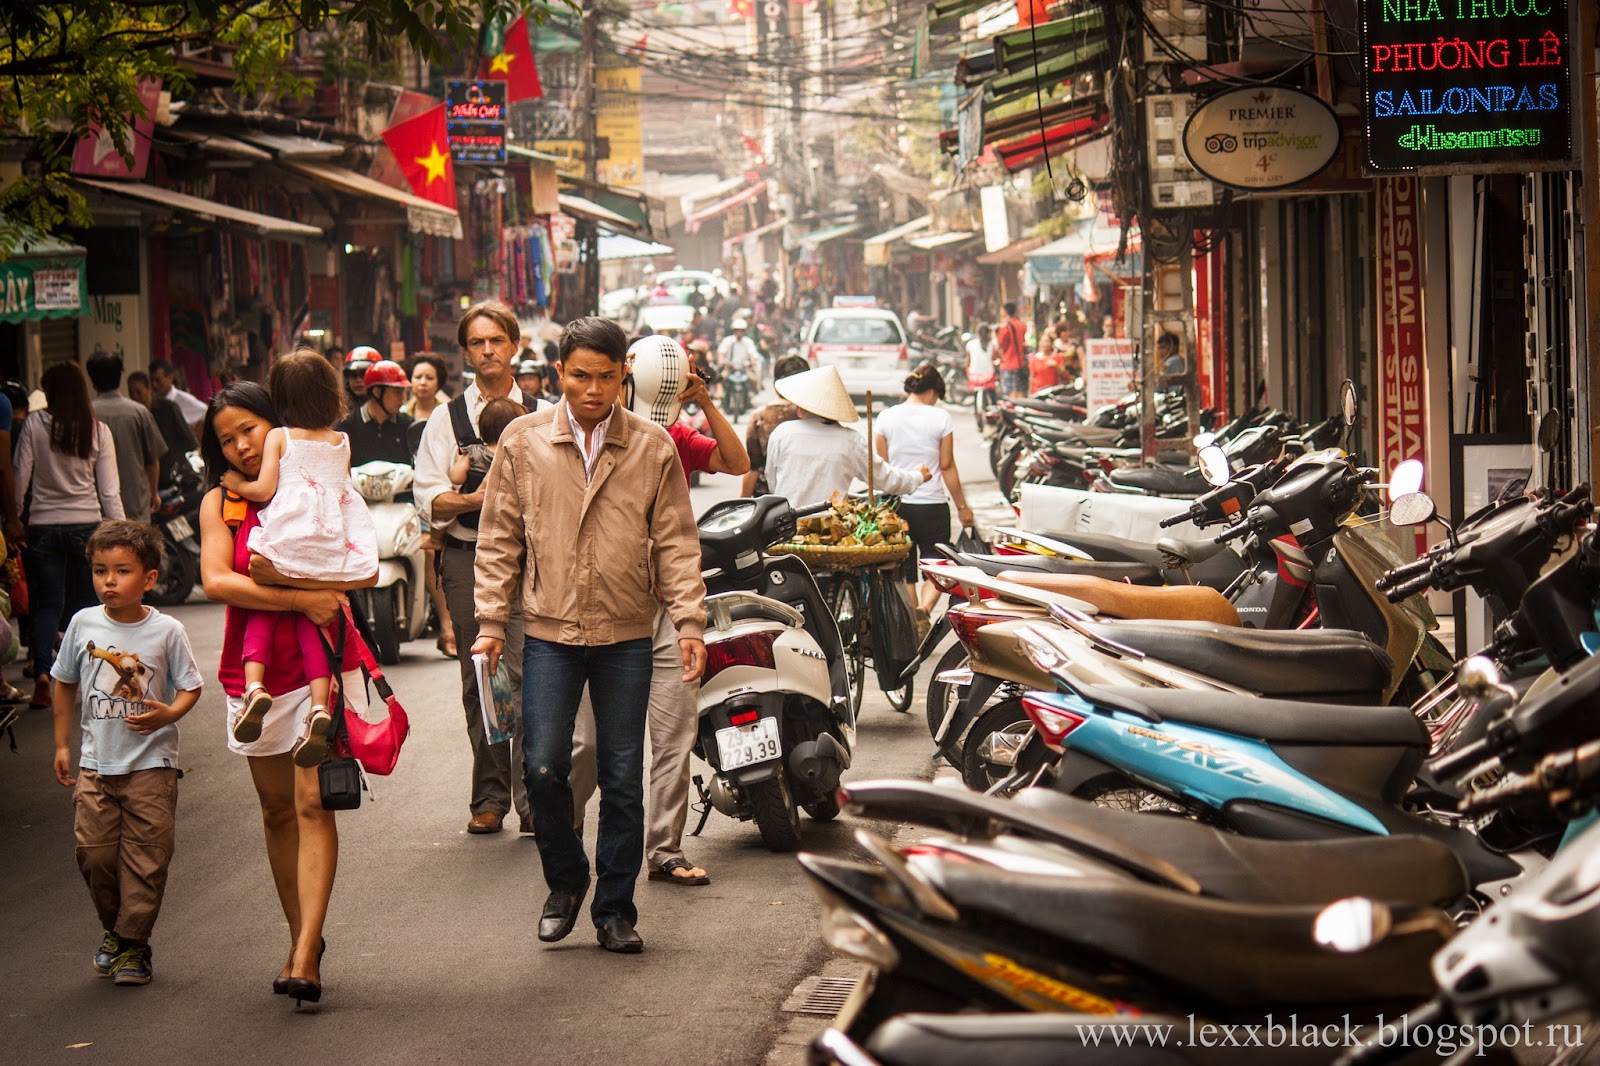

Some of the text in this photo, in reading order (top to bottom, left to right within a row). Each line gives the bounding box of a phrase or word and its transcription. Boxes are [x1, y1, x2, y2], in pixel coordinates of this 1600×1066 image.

[1518, 29, 1562, 67] LÊ
[1229, 106, 1296, 121] PREMIER
[1374, 83, 1559, 117] SALONPAS
[1243, 132, 1317, 151] tripadvisor
[1395, 176, 1416, 325] MUSIC
[1401, 354, 1421, 458] VIES
[724, 739, 779, 769] 229.39
